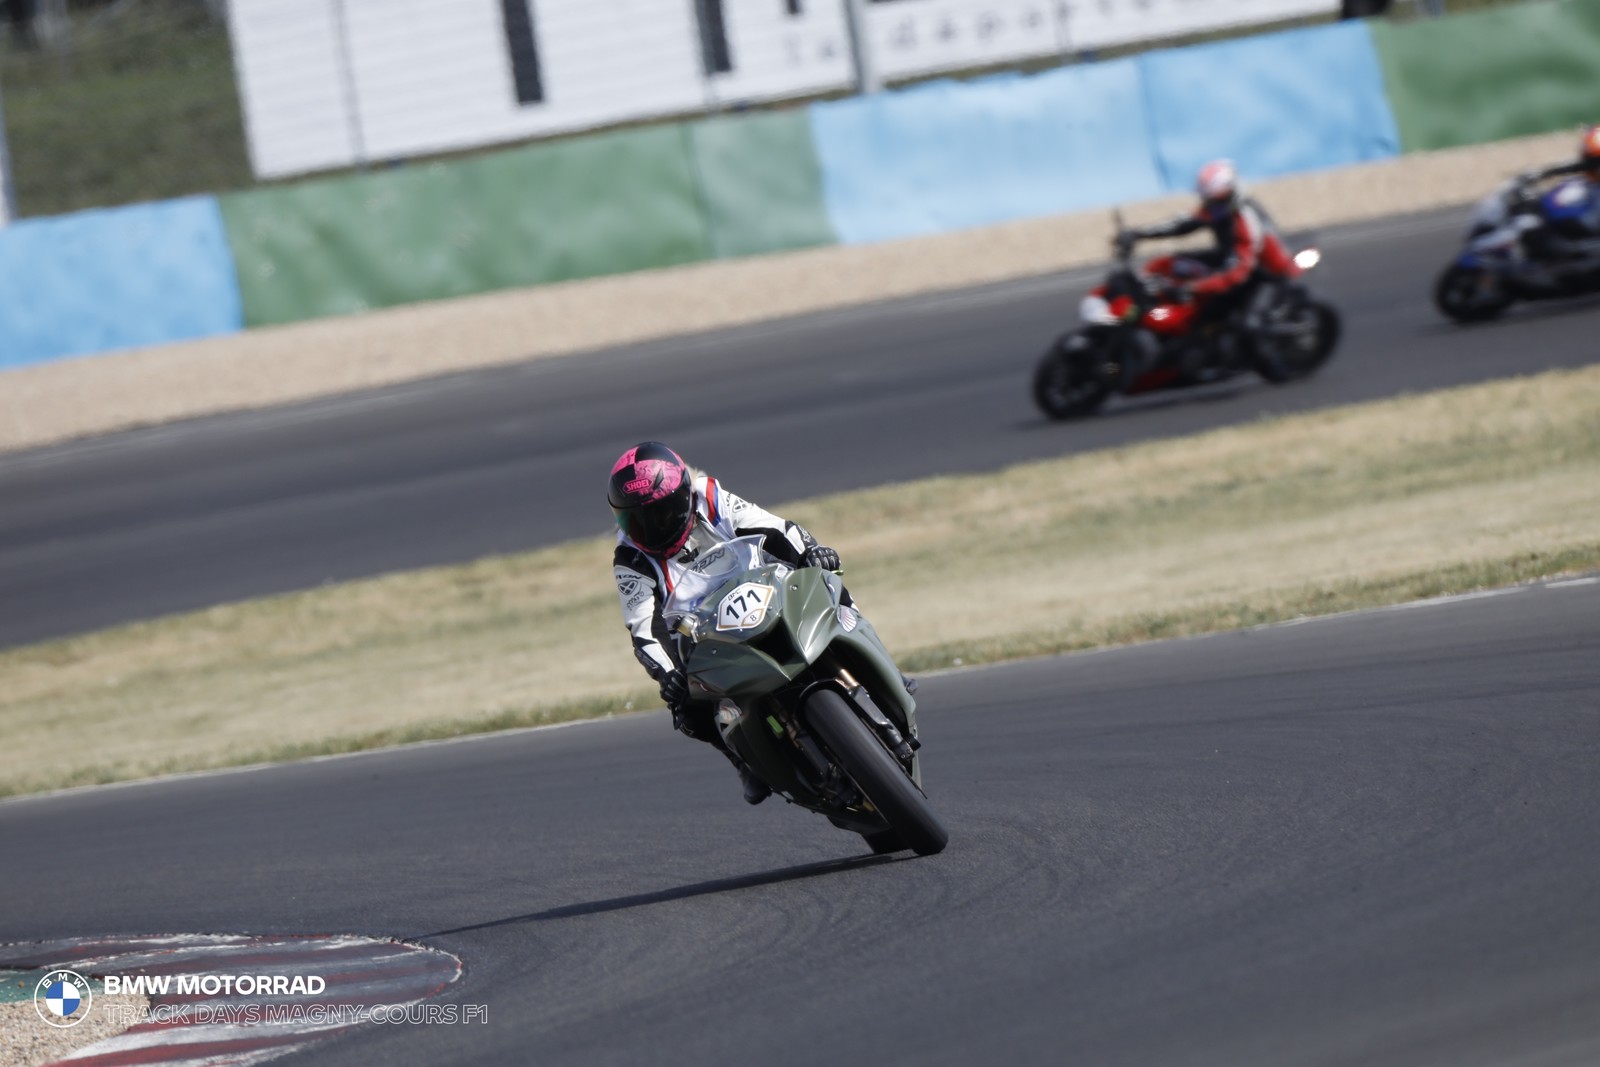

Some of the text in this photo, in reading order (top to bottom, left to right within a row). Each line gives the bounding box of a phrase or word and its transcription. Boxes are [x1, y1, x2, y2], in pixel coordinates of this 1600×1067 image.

[626, 479, 650, 491] SHOEI
[726, 589, 762, 620] 171
[750, 614, 757, 622] 8
